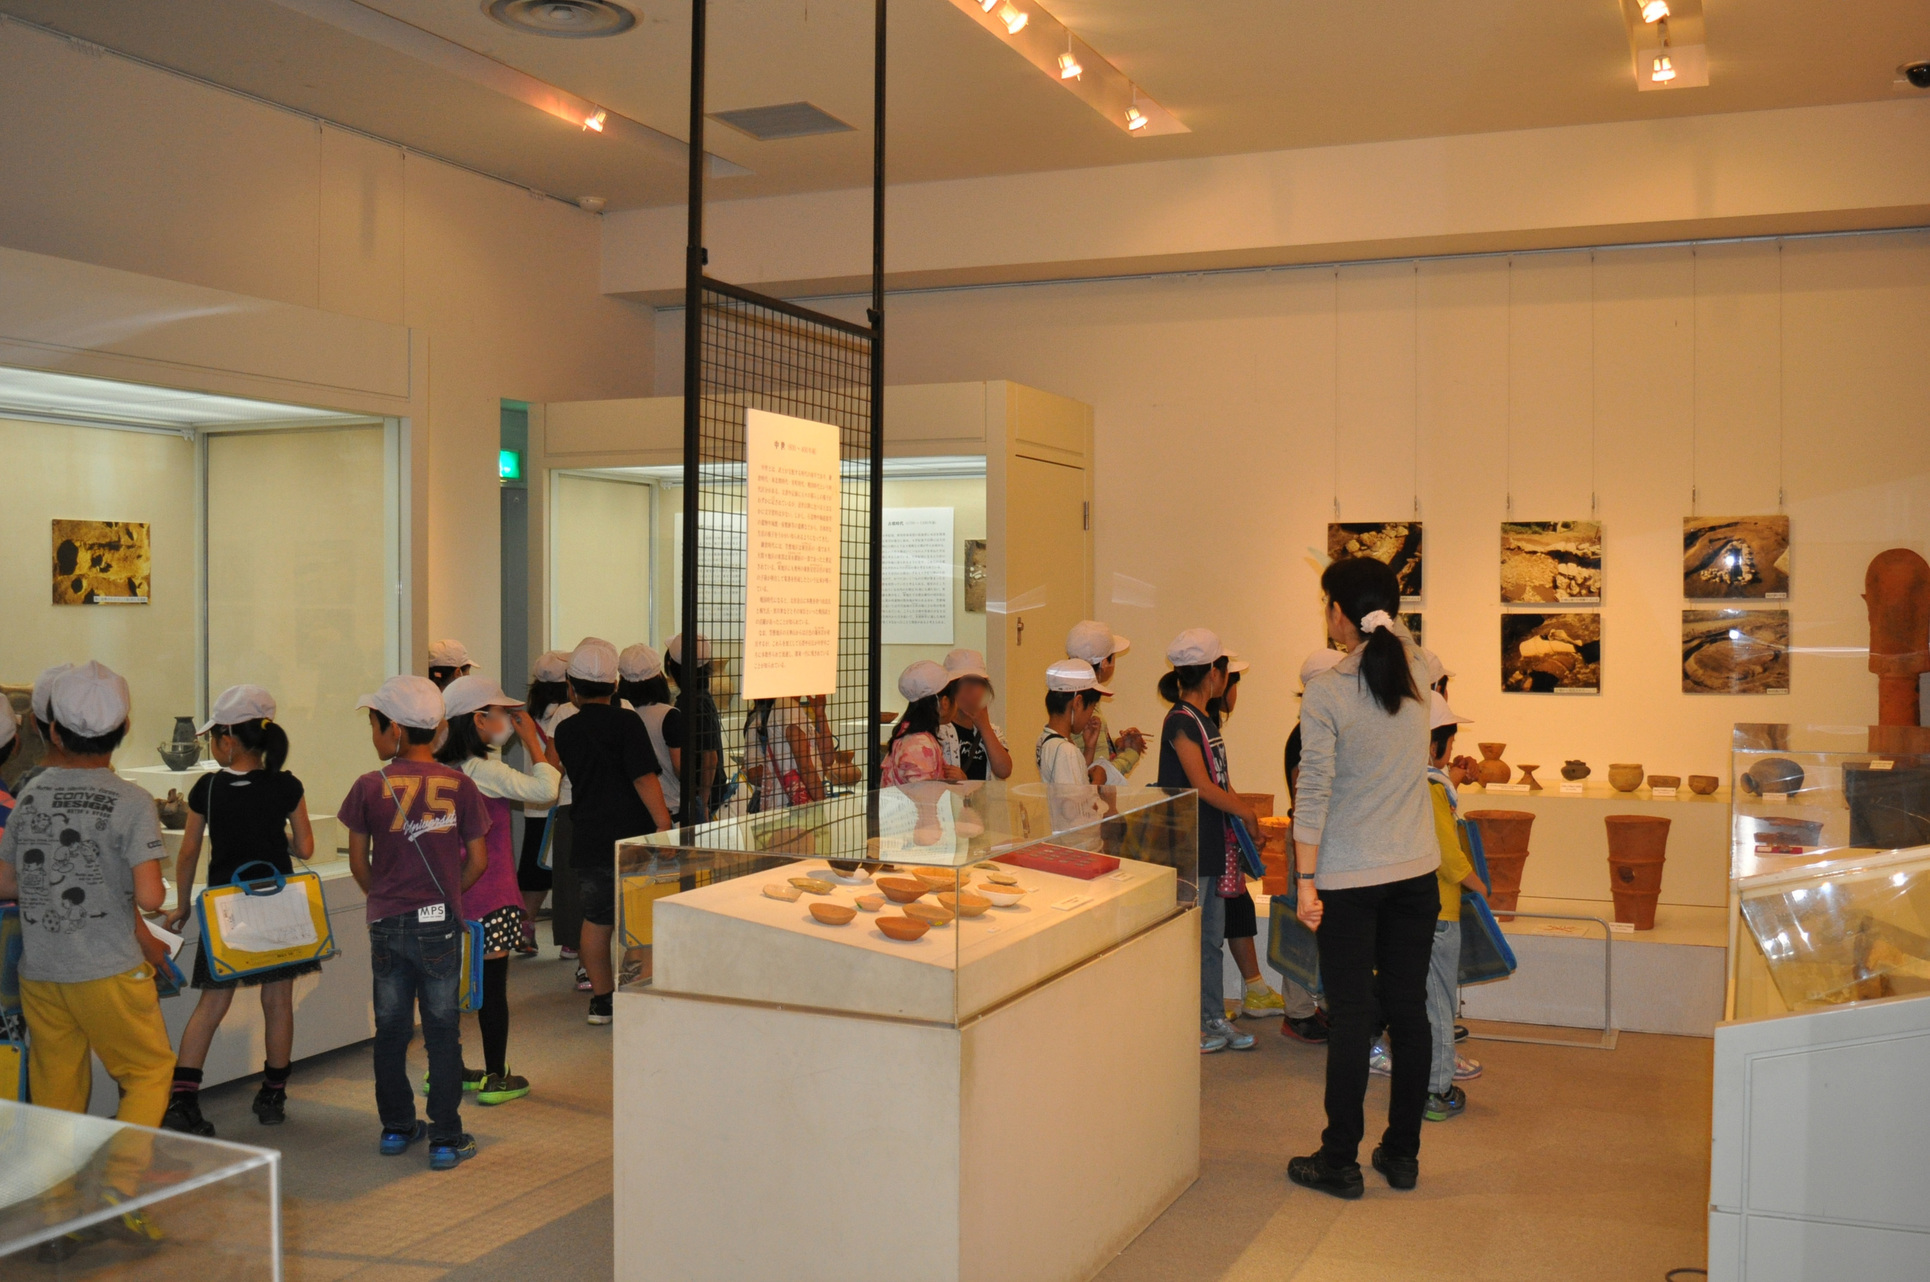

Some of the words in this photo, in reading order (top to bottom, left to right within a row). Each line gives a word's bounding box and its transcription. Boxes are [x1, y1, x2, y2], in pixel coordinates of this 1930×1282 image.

[52, 800, 114, 813] DESIGN
[382, 774, 461, 834] 75
[420, 905, 444, 916] MPS
